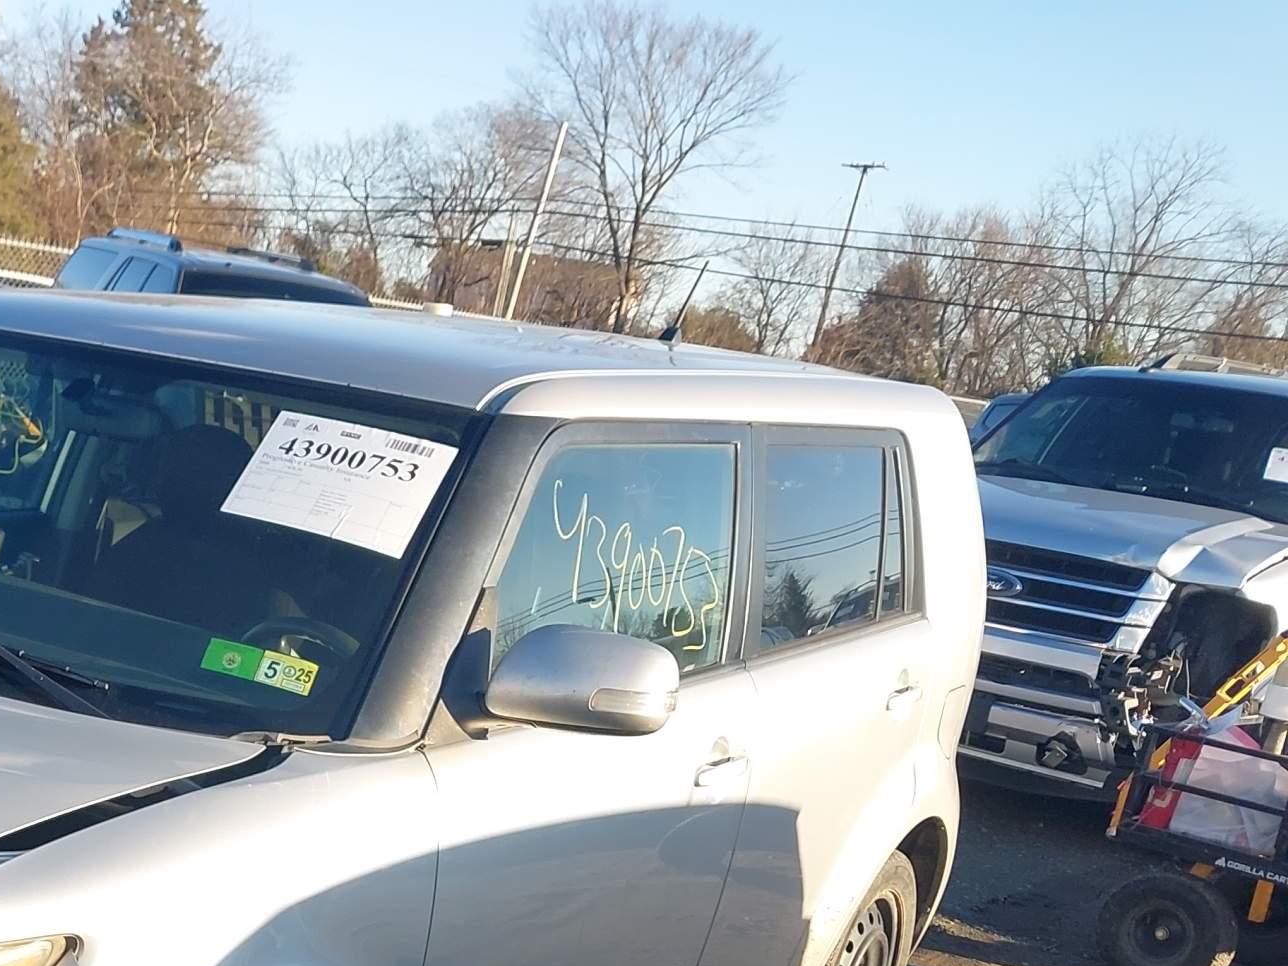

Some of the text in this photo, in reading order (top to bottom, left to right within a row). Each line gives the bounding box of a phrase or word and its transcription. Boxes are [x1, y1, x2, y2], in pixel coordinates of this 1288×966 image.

[279, 437, 420, 482] 43900753
[552, 479, 719, 651] 43900753
[264, 660, 314, 684] 5 25
